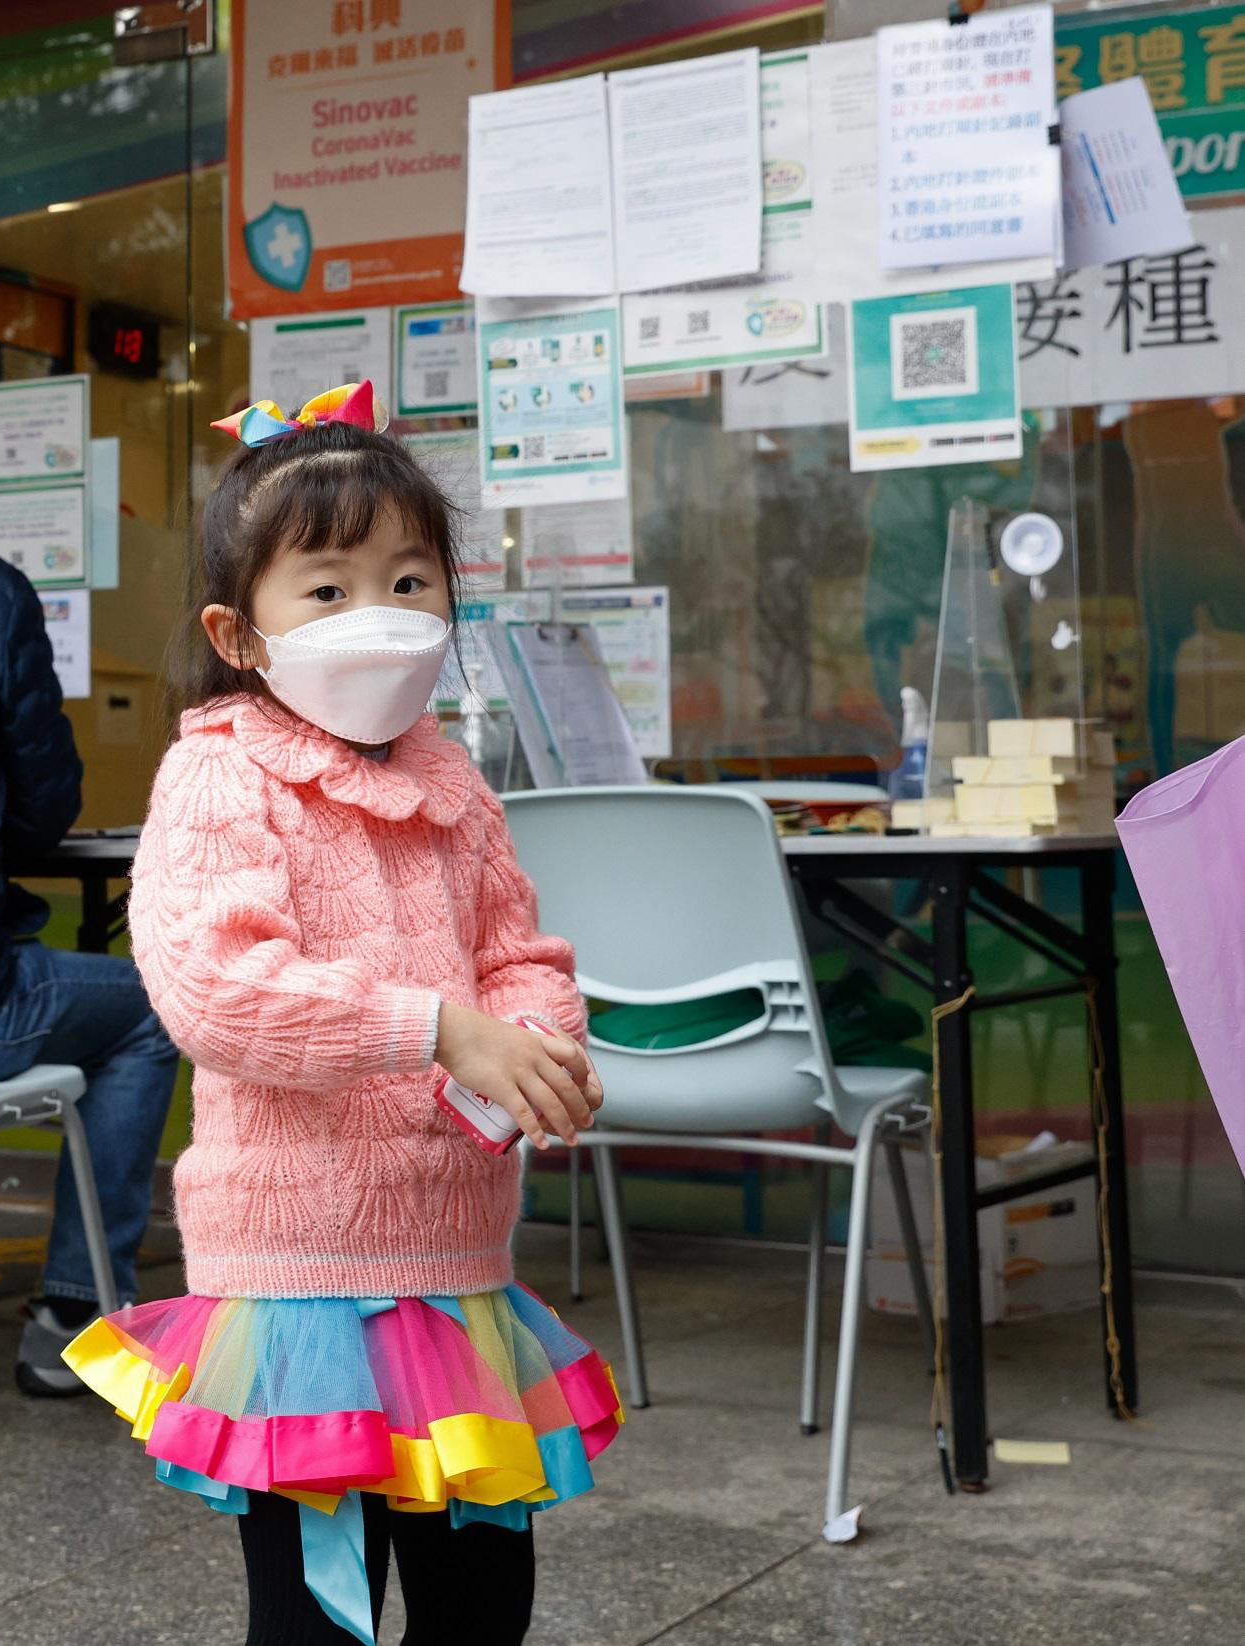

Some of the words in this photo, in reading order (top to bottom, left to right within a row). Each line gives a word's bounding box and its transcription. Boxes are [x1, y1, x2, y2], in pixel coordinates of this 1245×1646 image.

[312, 95, 418, 129] Sinovac
[311, 129, 415, 158] CoronaVac
[273, 160, 380, 191] Inactivated
[384, 152, 461, 176] Vaccine
